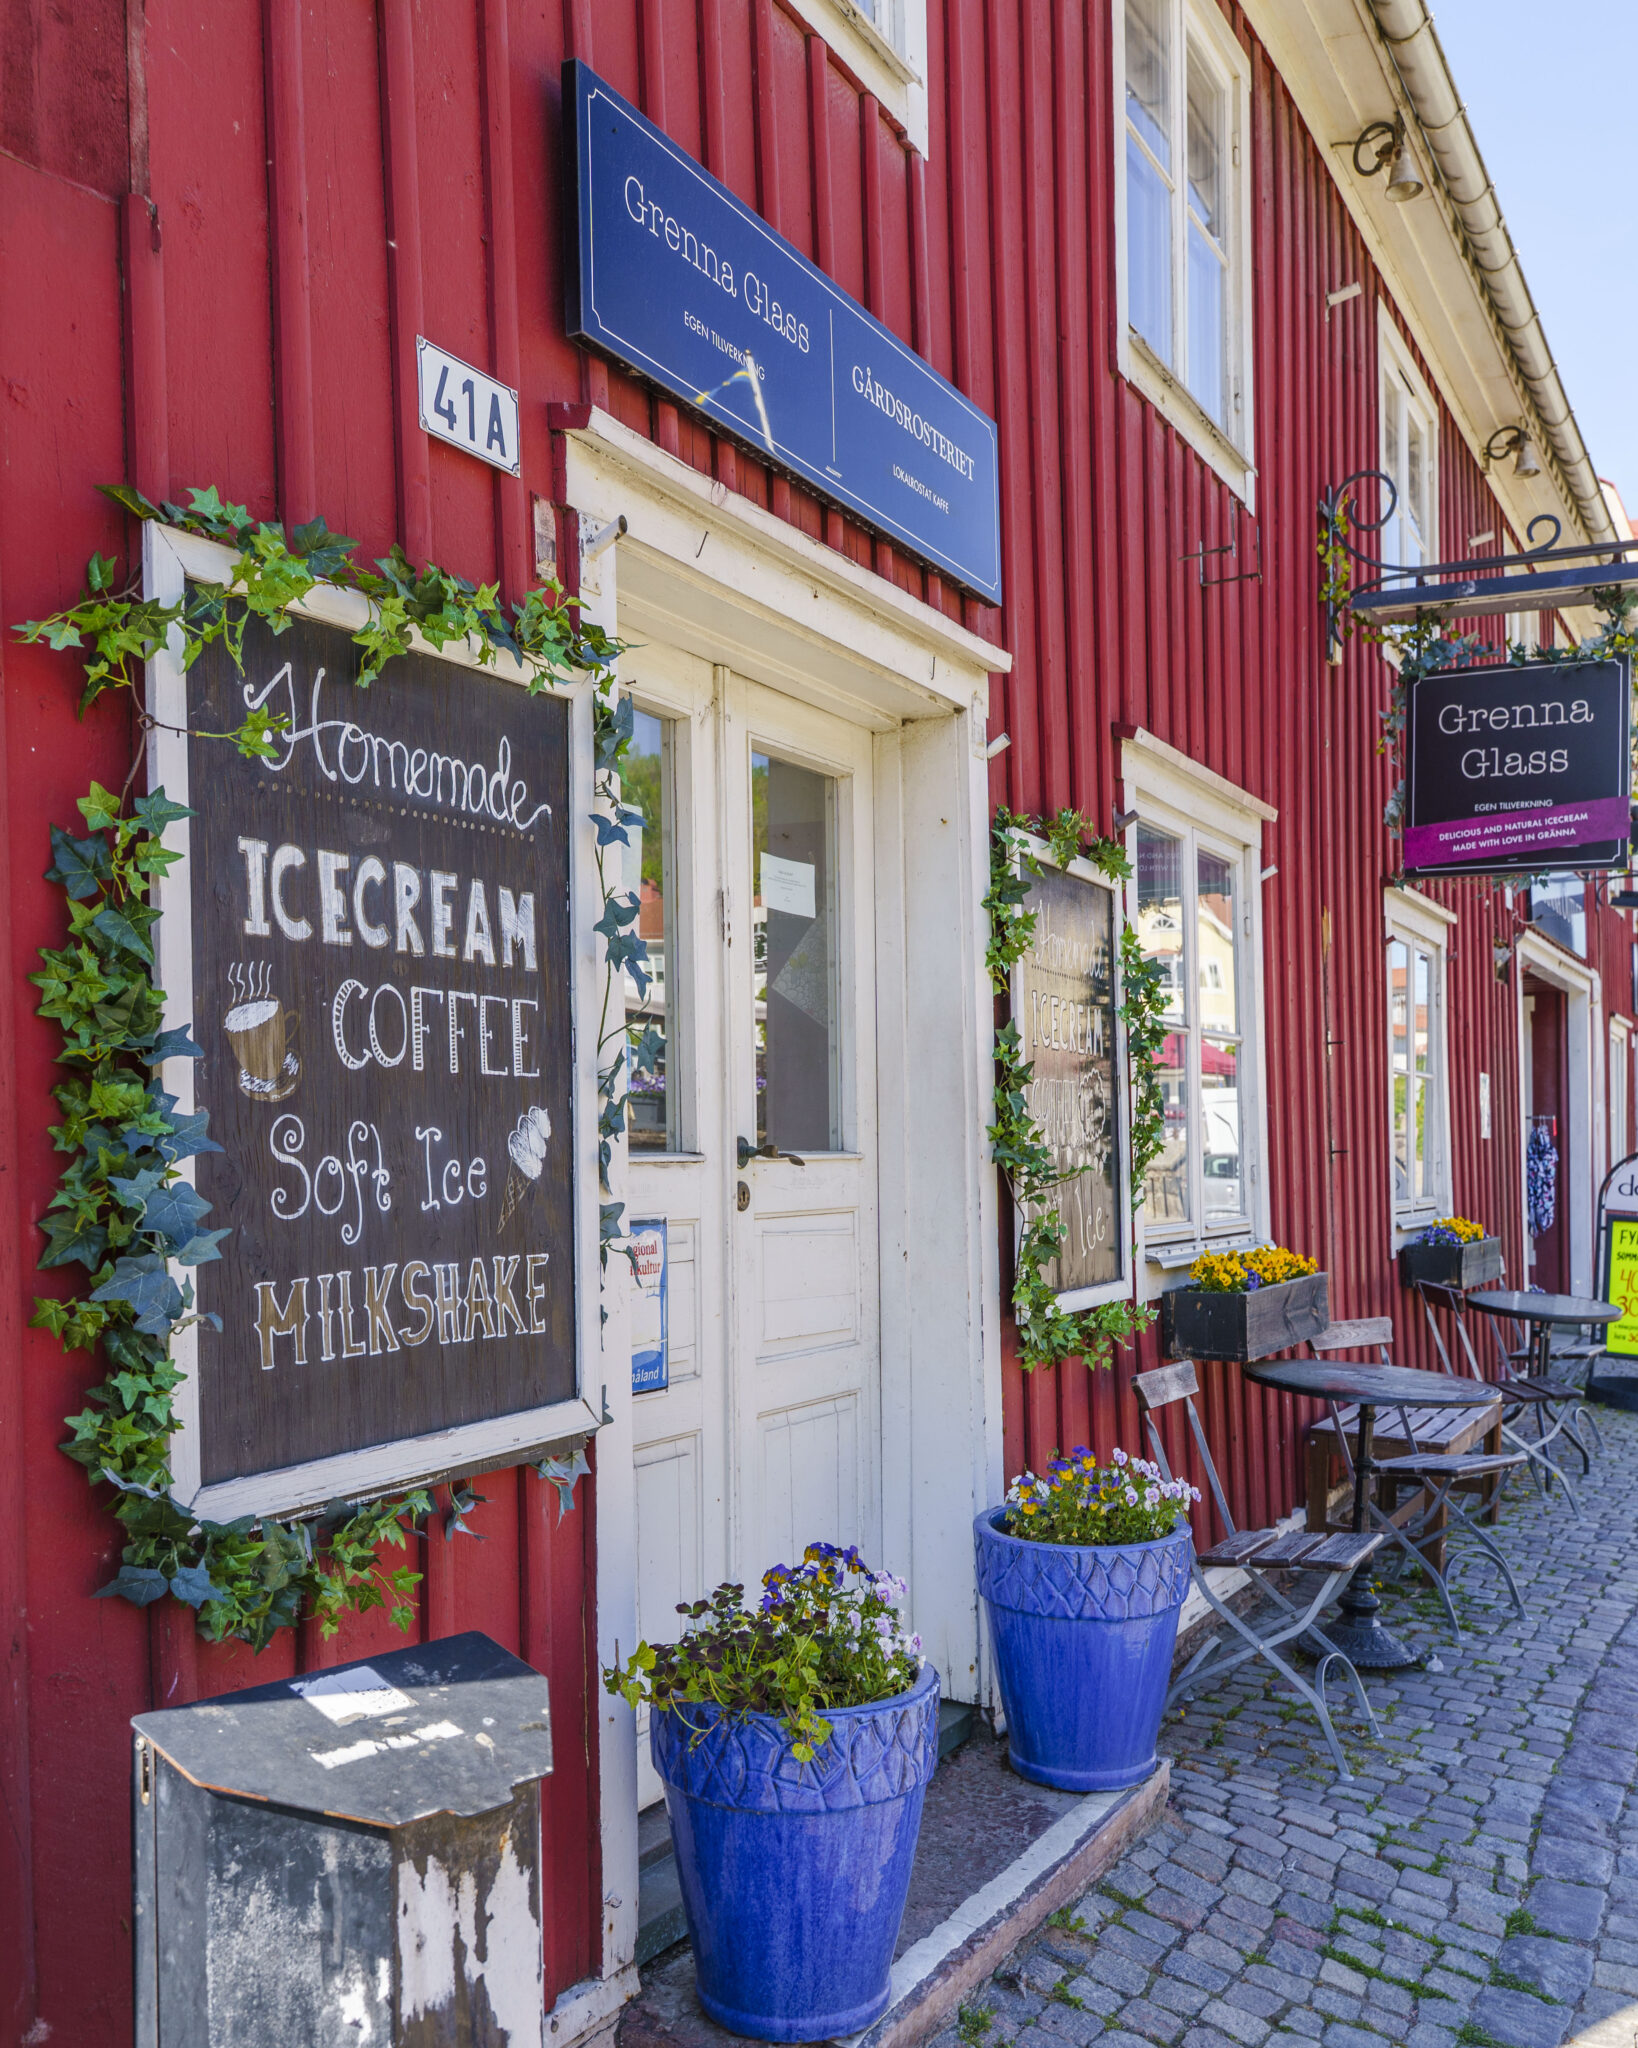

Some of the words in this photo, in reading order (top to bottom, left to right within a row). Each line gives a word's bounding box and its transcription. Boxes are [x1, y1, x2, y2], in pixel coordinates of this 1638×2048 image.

[624, 176, 737, 297] Grenna
[744, 272, 809, 353] Glass
[684, 311, 709, 341] EGEN
[852, 365, 975, 481] GÅRDSROSTERIET
[933, 494, 949, 514] KAFFE
[243, 662, 552, 830] Homemade
[1438, 699, 1594, 735] Grenna
[1461, 747, 1569, 779] Glass
[1438, 827, 1482, 842] DELICIOUS
[1483, 824, 1503, 835] AND
[1504, 819, 1542, 832] NATURAL
[1544, 812, 1589, 826] ICECREAM
[1474, 802, 1497, 812] EGEN
[1499, 798, 1553, 810] TILLVERKNING
[1452, 841, 1477, 853] MADE
[1479, 837, 1500, 848] WITH
[1502, 834, 1523, 845] LOVE
[1525, 832, 1536, 842] IN
[1537, 827, 1577, 841] GRÄNNA
[237, 835, 538, 972] ICECREAM
[333, 979, 540, 1077] COFFEE
[1032, 989, 1104, 1058] ICECREAM
[270, 1113, 391, 1245] Soft
[415, 1126, 487, 1211] Ice
[1075, 1185, 1105, 1257] Ice
[1620, 1229, 1638, 1246] FY
[253, 1253, 549, 1370] MILKSHAKE
